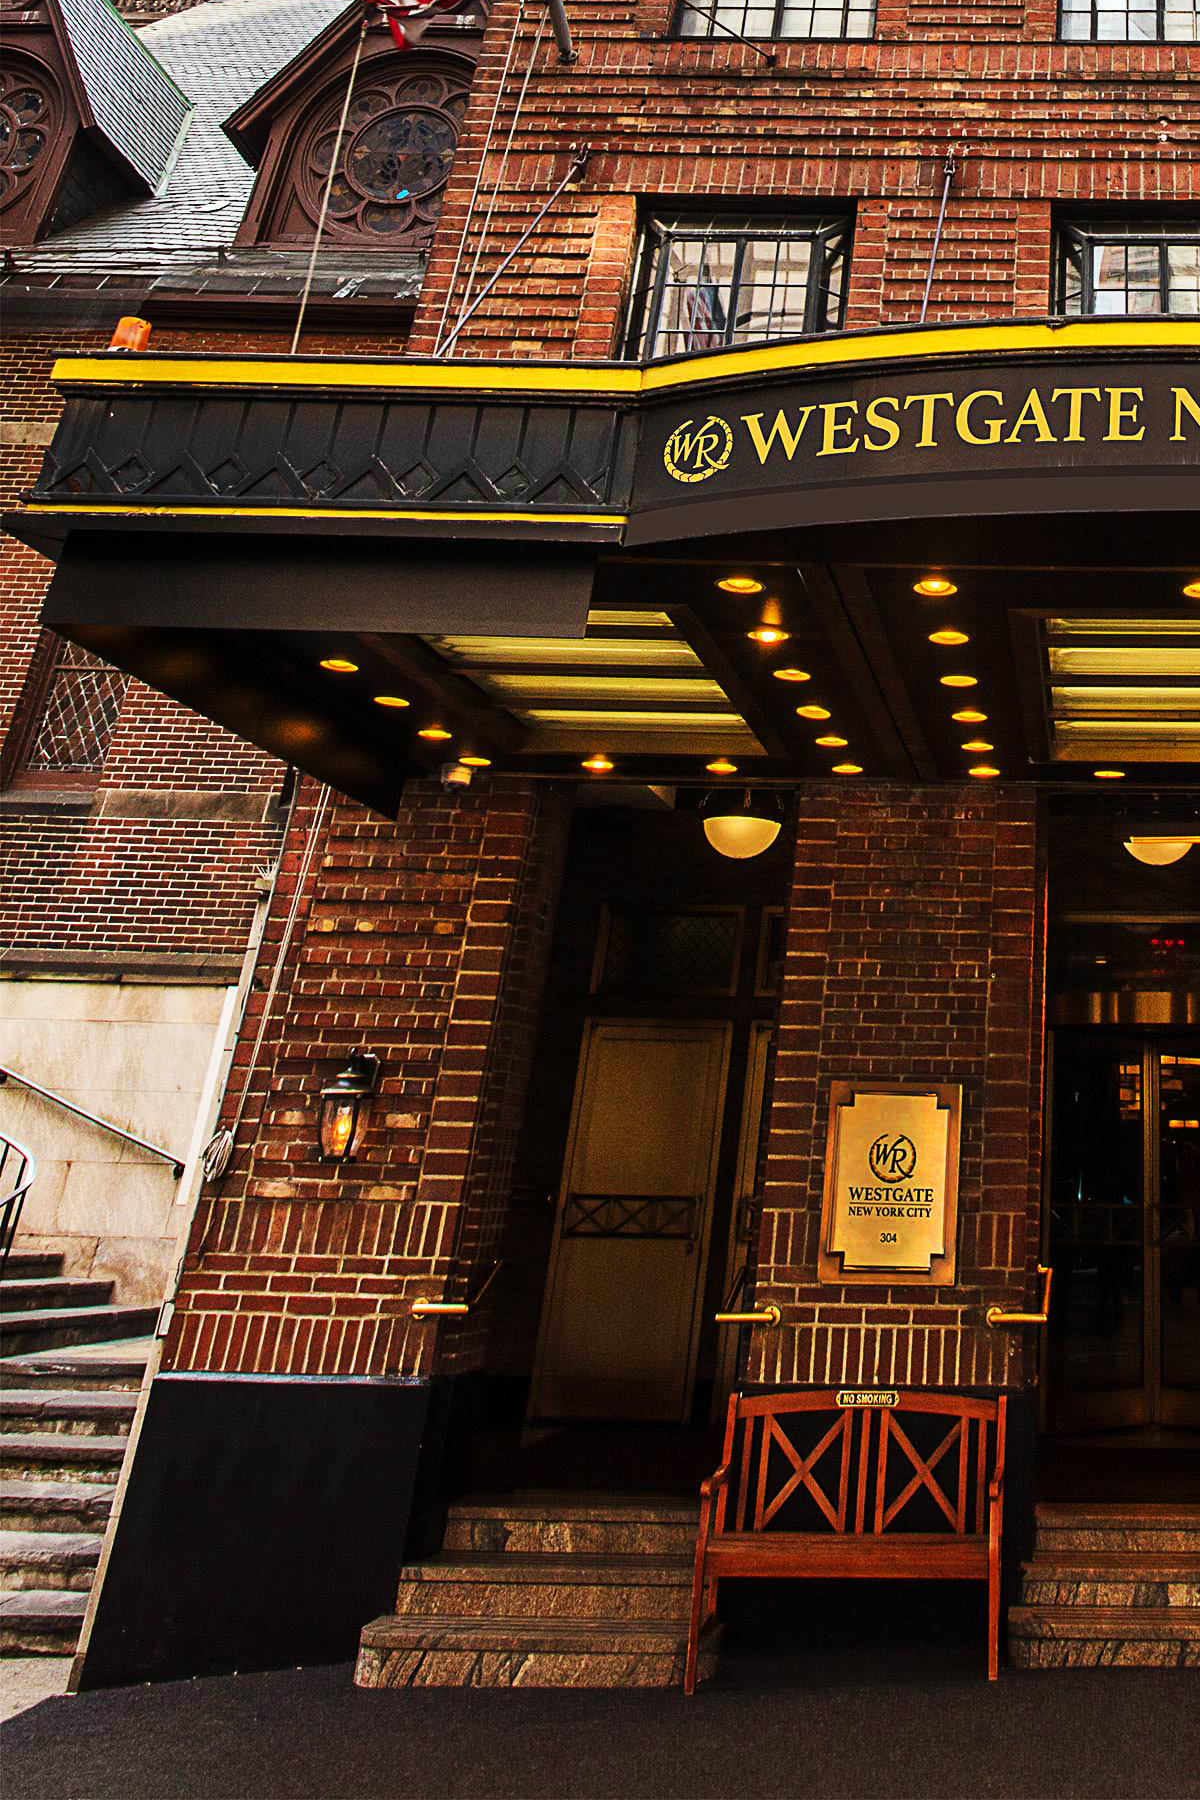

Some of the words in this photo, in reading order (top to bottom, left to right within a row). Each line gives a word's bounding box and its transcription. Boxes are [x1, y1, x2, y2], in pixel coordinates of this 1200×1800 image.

[740, 386, 1147, 465] WESTGATE
[848, 1186, 934, 1203] WESTGATE
[848, 1206, 873, 1217] NEW
[875, 1206, 905, 1218] YORK
[906, 1207, 932, 1218] CITY
[879, 1232, 897, 1244] 304
[843, 1393, 855, 1404] NO
[856, 1393, 893, 1404] SMOKING
